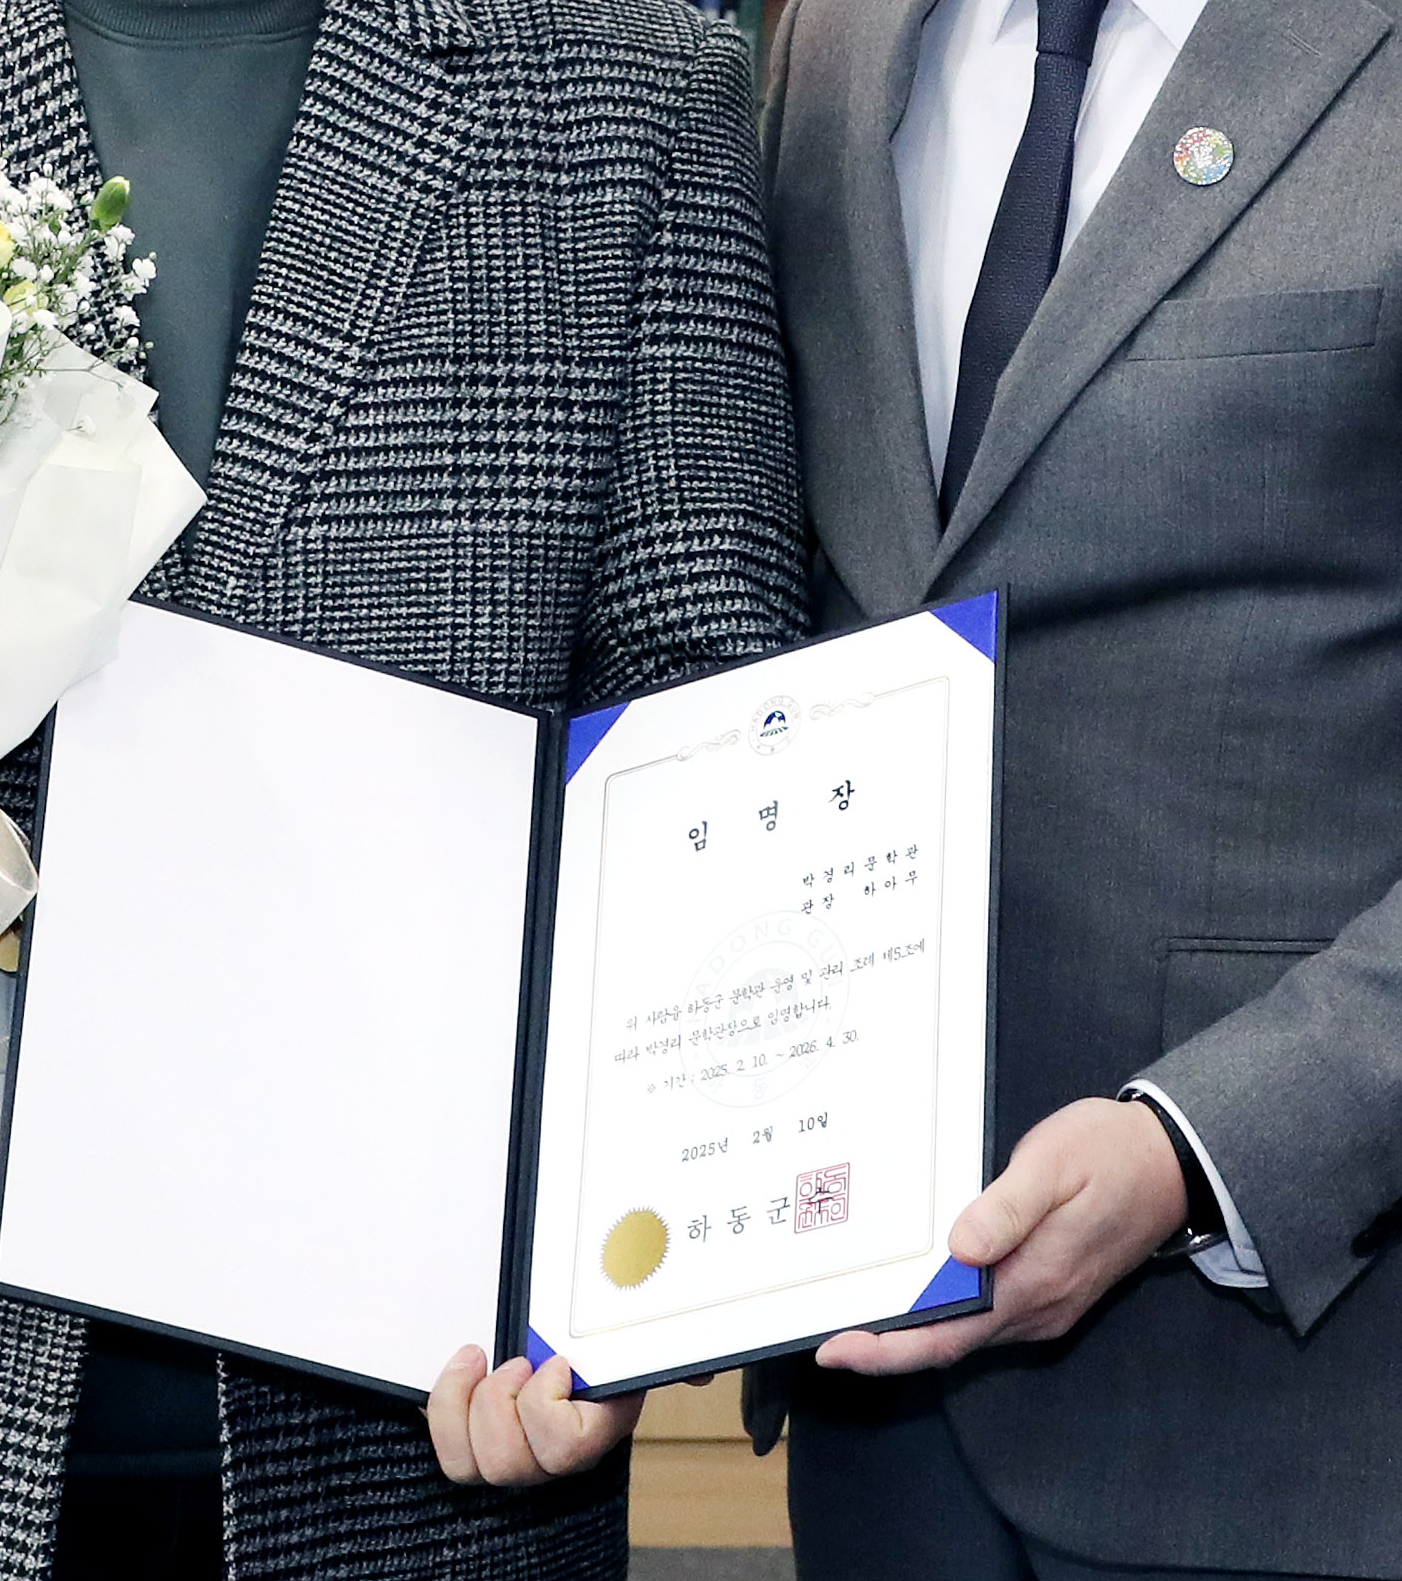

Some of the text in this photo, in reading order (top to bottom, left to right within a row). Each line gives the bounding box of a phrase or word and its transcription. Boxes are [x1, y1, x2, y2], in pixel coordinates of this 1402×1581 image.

[626, 1016, 637, 1031] 위
[688, 994, 724, 1014] 하동군
[729, 982, 765, 1005] 문학관
[770, 974, 794, 994] 운영
[819, 961, 843, 981] 관리
[614, 1046, 640, 1064] 따라
[681, 1137, 728, 1162] 2025년
[798, 1112, 828, 1133] 10일
